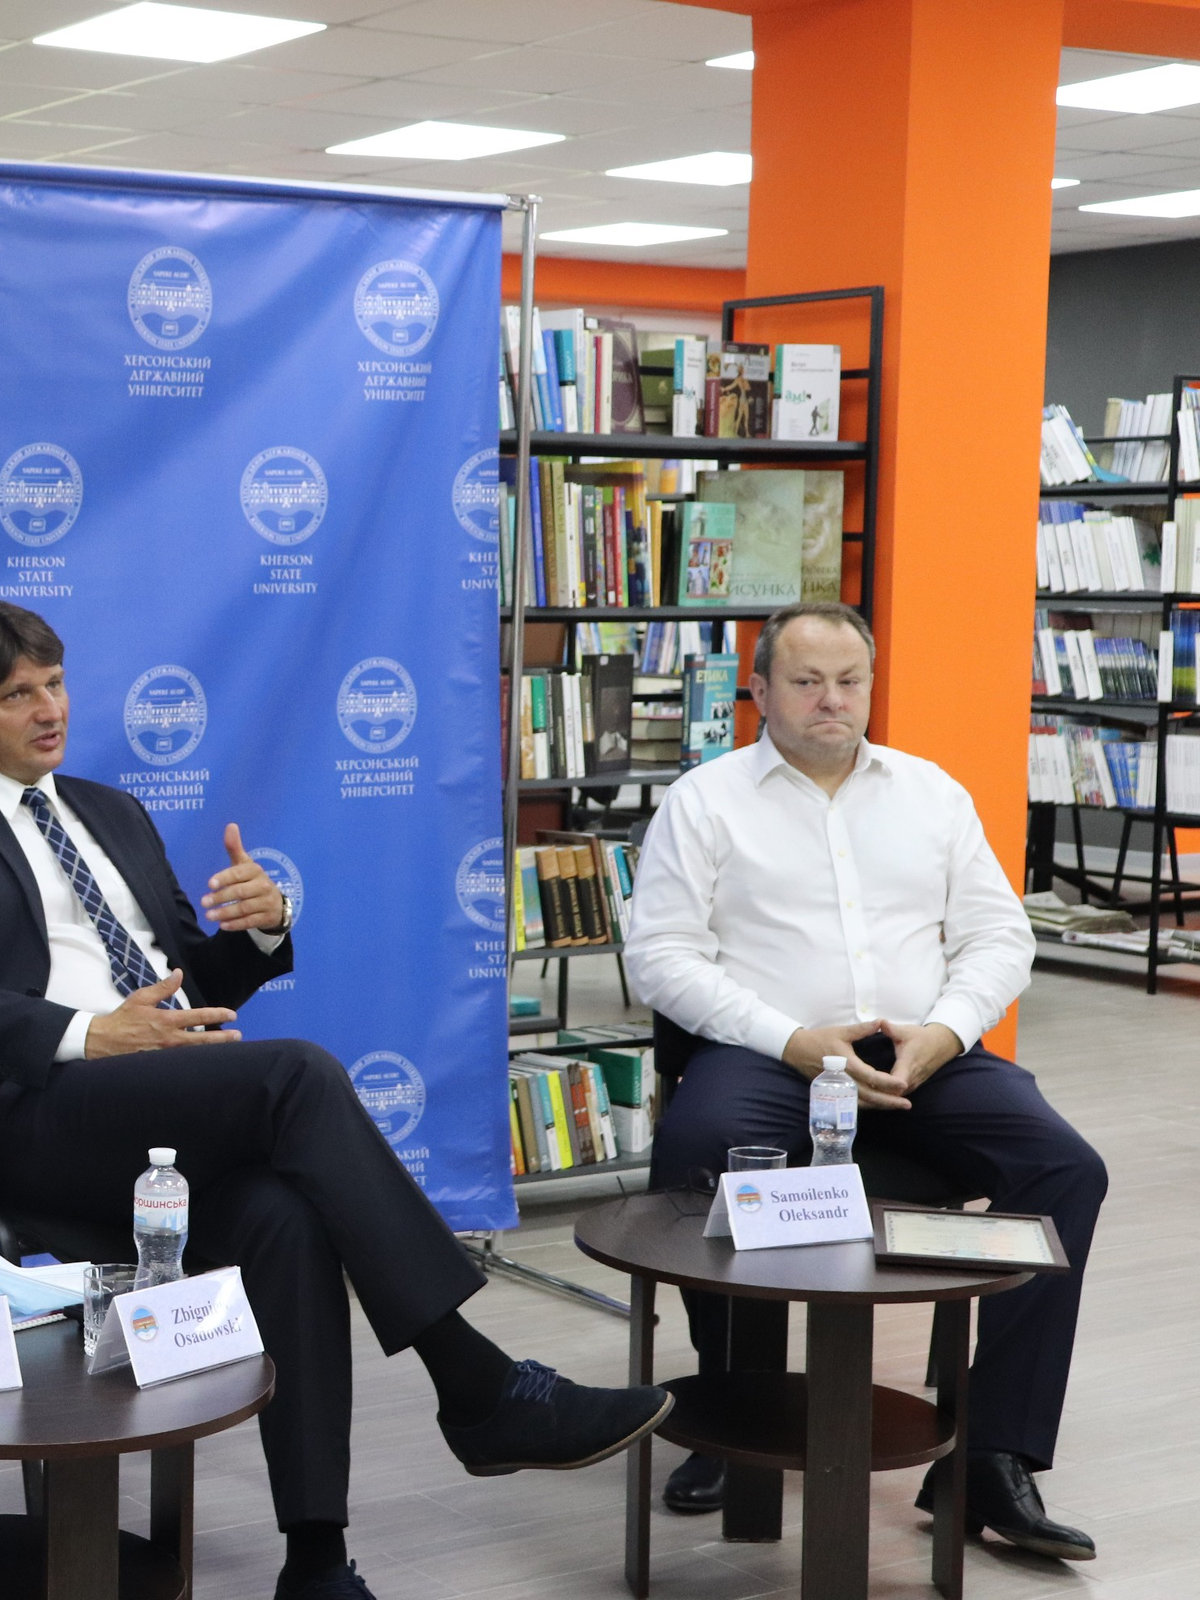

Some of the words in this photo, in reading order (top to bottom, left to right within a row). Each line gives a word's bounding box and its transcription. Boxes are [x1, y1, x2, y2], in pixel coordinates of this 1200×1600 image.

[124, 355, 211, 369] ХЕРСОНСЬКИЙ
[357, 361, 431, 374] ХЕРСОНСЬКИЙ
[130, 370, 204, 383] ДЕРЖАВНИЙ
[365, 375, 426, 388] ДЕРЖАВНИЙ
[128, 384, 203, 397] УНІВЕРСИТЕТ
[364, 388, 425, 401] УНІВЕРСИТЕТ
[7, 556, 65, 568] KHERSON
[260, 554, 313, 566] KHERSON
[18, 571, 54, 582] STATE
[270, 568, 301, 580] STATE
[0, 585, 73, 597] UNIVERSITY
[253, 582, 318, 594] UNIVERSITY
[335, 756, 418, 770] ХЕРСОНСЬКИЙ
[119, 768, 210, 784] ХЕРСОНСЬКИЙ
[342, 770, 414, 784] ДЕРЖАВНИЙ
[341, 784, 414, 797] УНІВЕРСИТЕТ
[141, 798, 204, 811] ВЕРСИТЕТ
[770, 1187, 849, 1203] Samoilenko
[779, 1206, 849, 1222] Oleksandr
